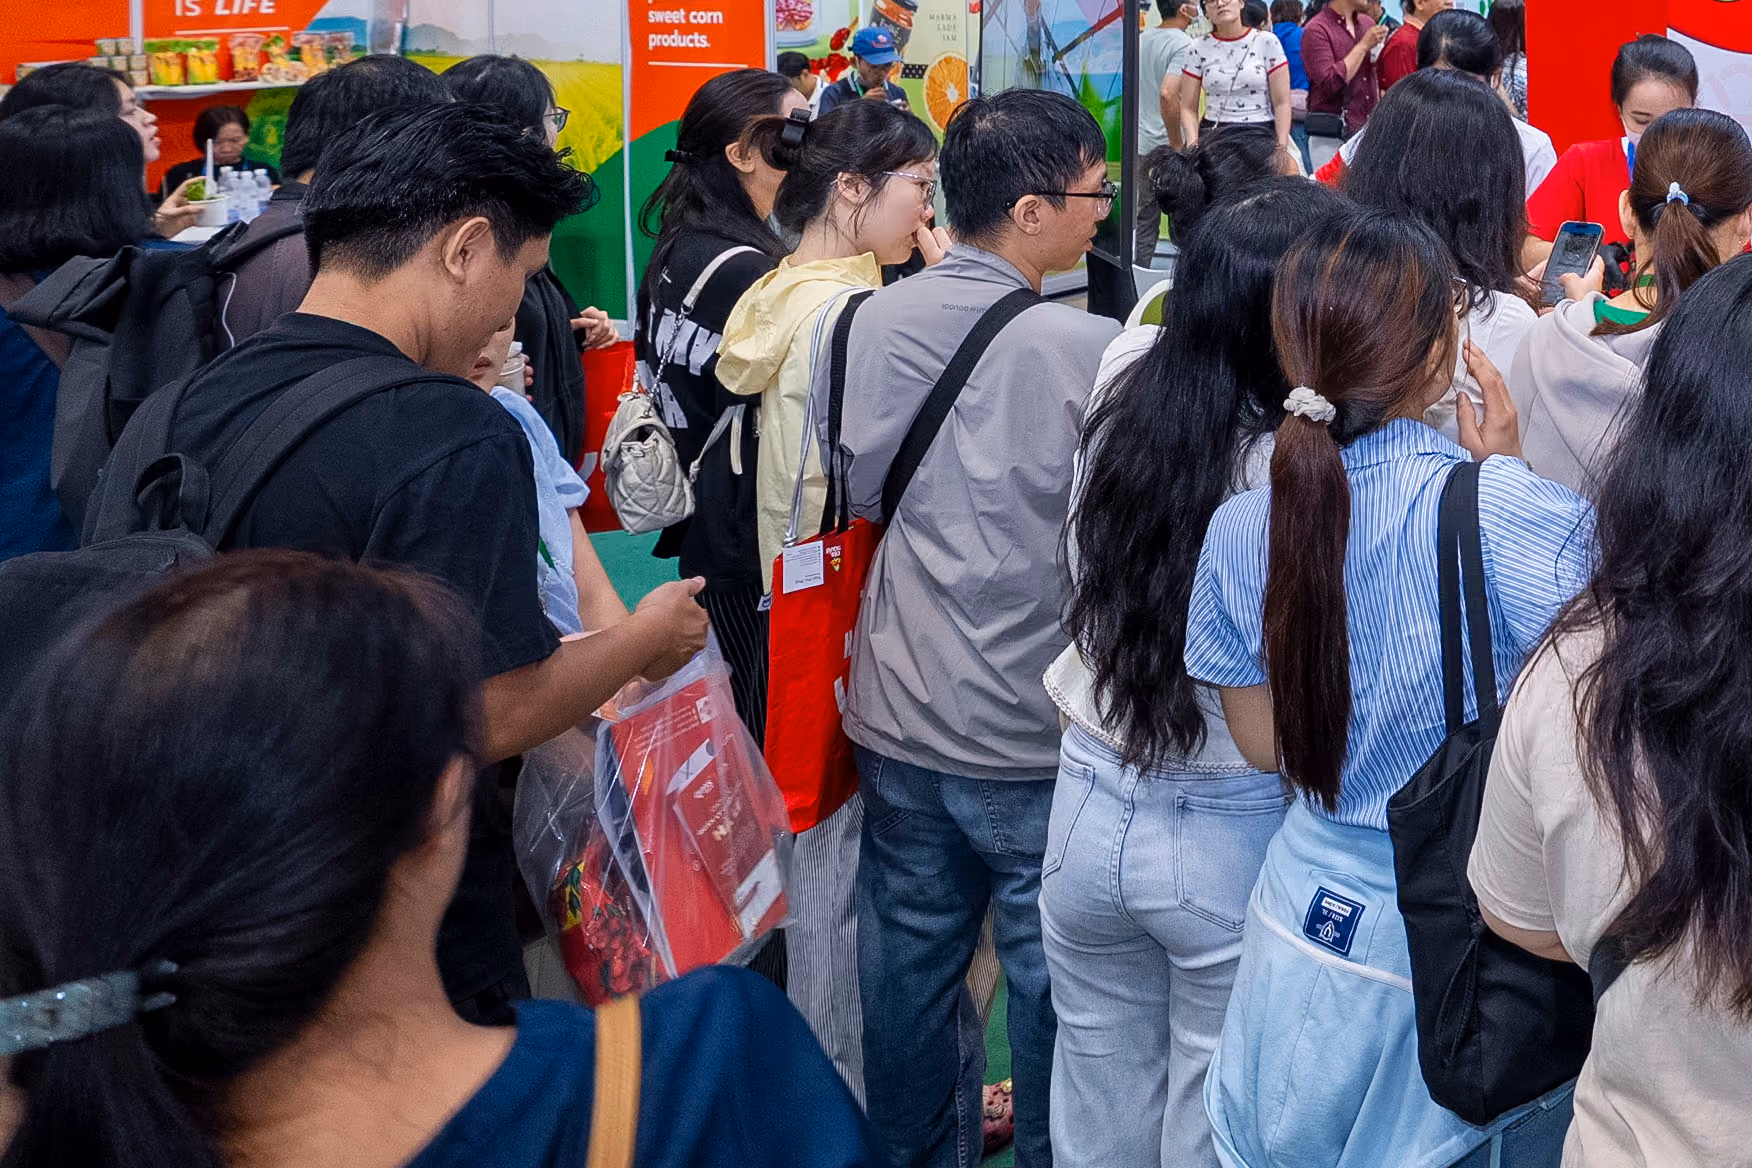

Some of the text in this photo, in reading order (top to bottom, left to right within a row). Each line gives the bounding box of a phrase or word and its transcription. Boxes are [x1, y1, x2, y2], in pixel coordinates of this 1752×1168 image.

[647, 7, 723, 25] sweet corn
[648, 30, 711, 52] products.
